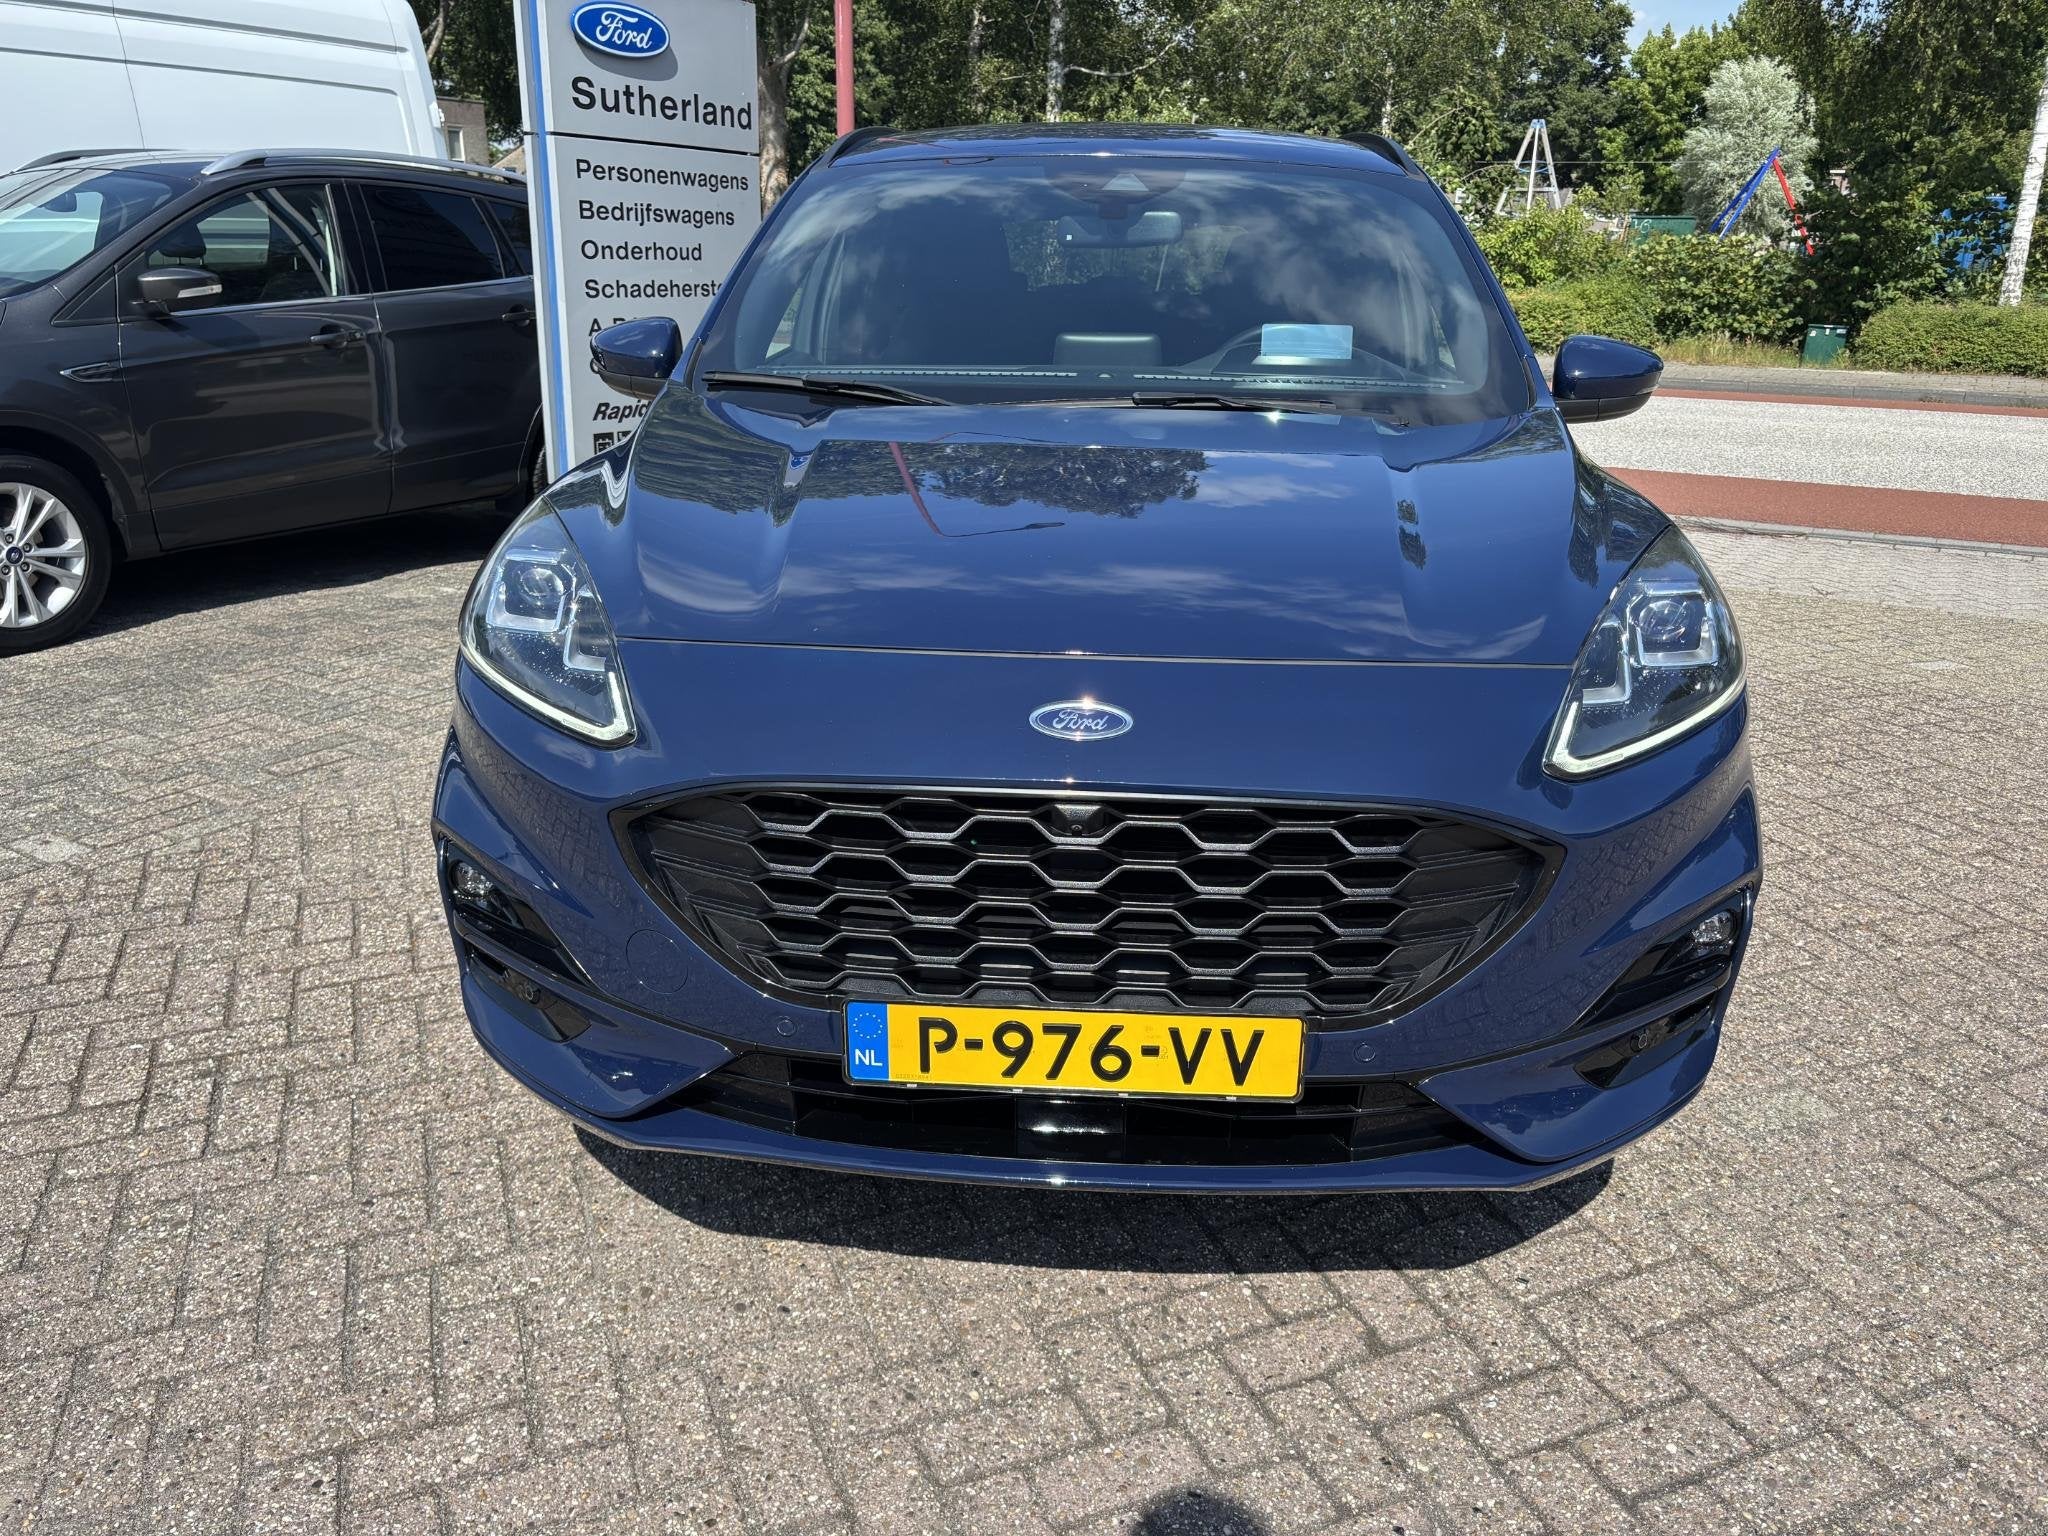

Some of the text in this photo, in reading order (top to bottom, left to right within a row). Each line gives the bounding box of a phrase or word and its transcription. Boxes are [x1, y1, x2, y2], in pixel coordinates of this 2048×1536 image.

[595, 10, 653, 50] Ford
[571, 76, 752, 130] Sutherland
[575, 158, 749, 192] Personenwagens
[578, 199, 735, 228] Bedrijfswagens
[580, 239, 703, 261] Onderhoud
[1052, 709, 1109, 730] Ford
[854, 1016, 1265, 1087] NL P-976-VV
